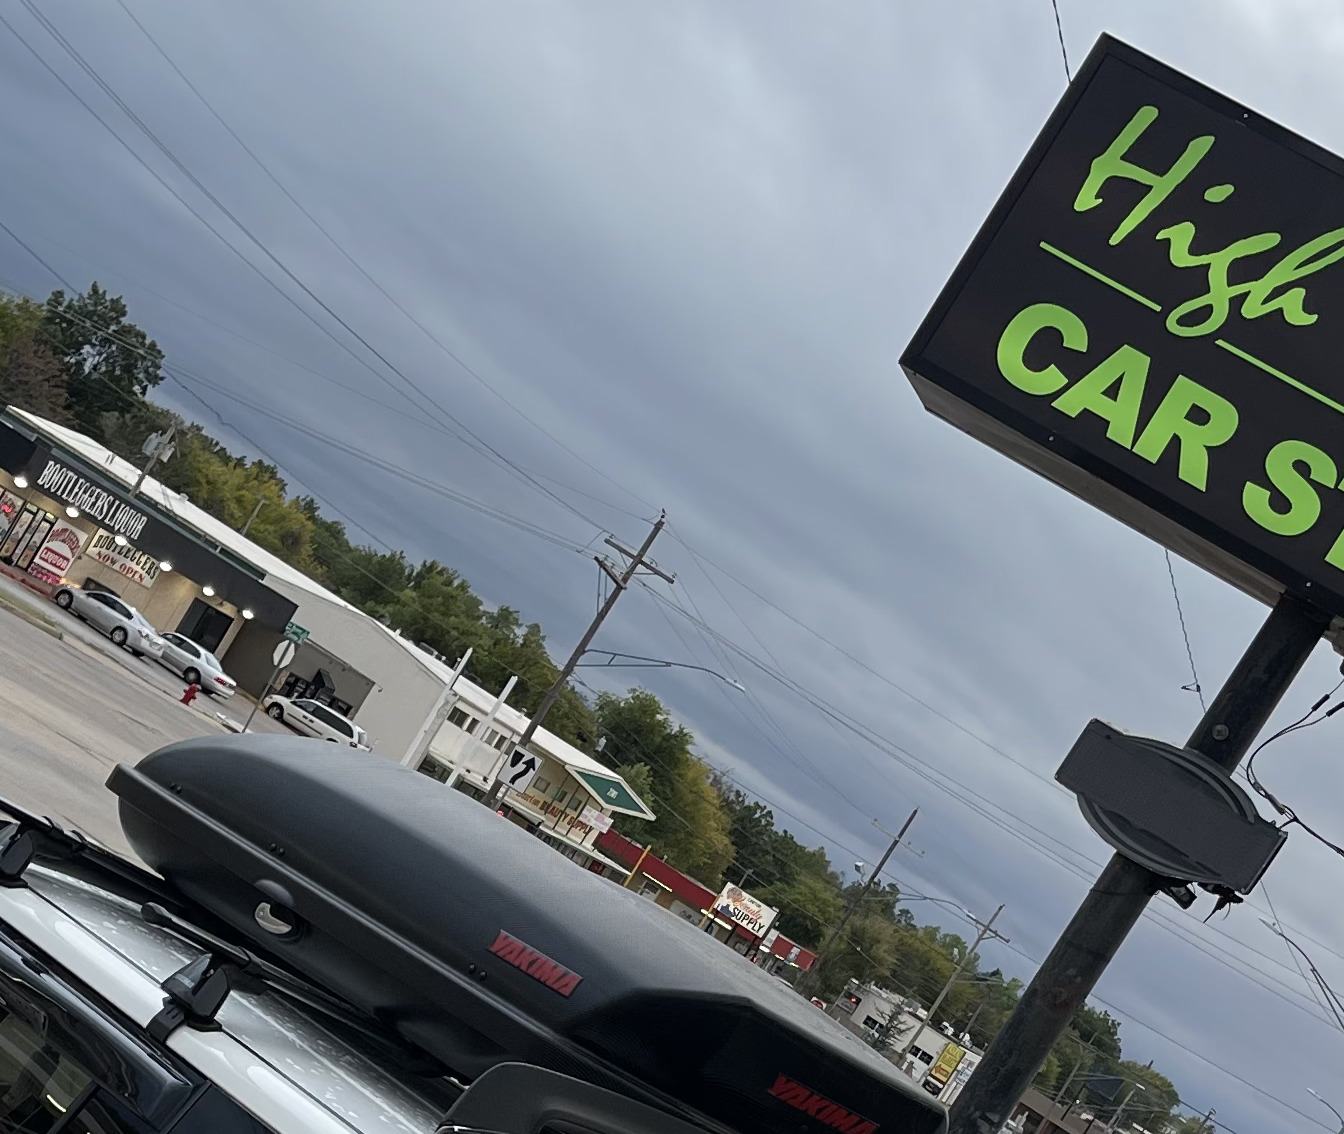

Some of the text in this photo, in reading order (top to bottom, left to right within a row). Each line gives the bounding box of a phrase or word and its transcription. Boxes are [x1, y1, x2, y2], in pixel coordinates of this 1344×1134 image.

[995, 302, 1240, 491] CAR
[37, 460, 149, 541] BOOTLEGGERS LIQUOR
[732, 906, 766, 933] SUPPLY
[488, 932, 581, 998] YAKIMA
